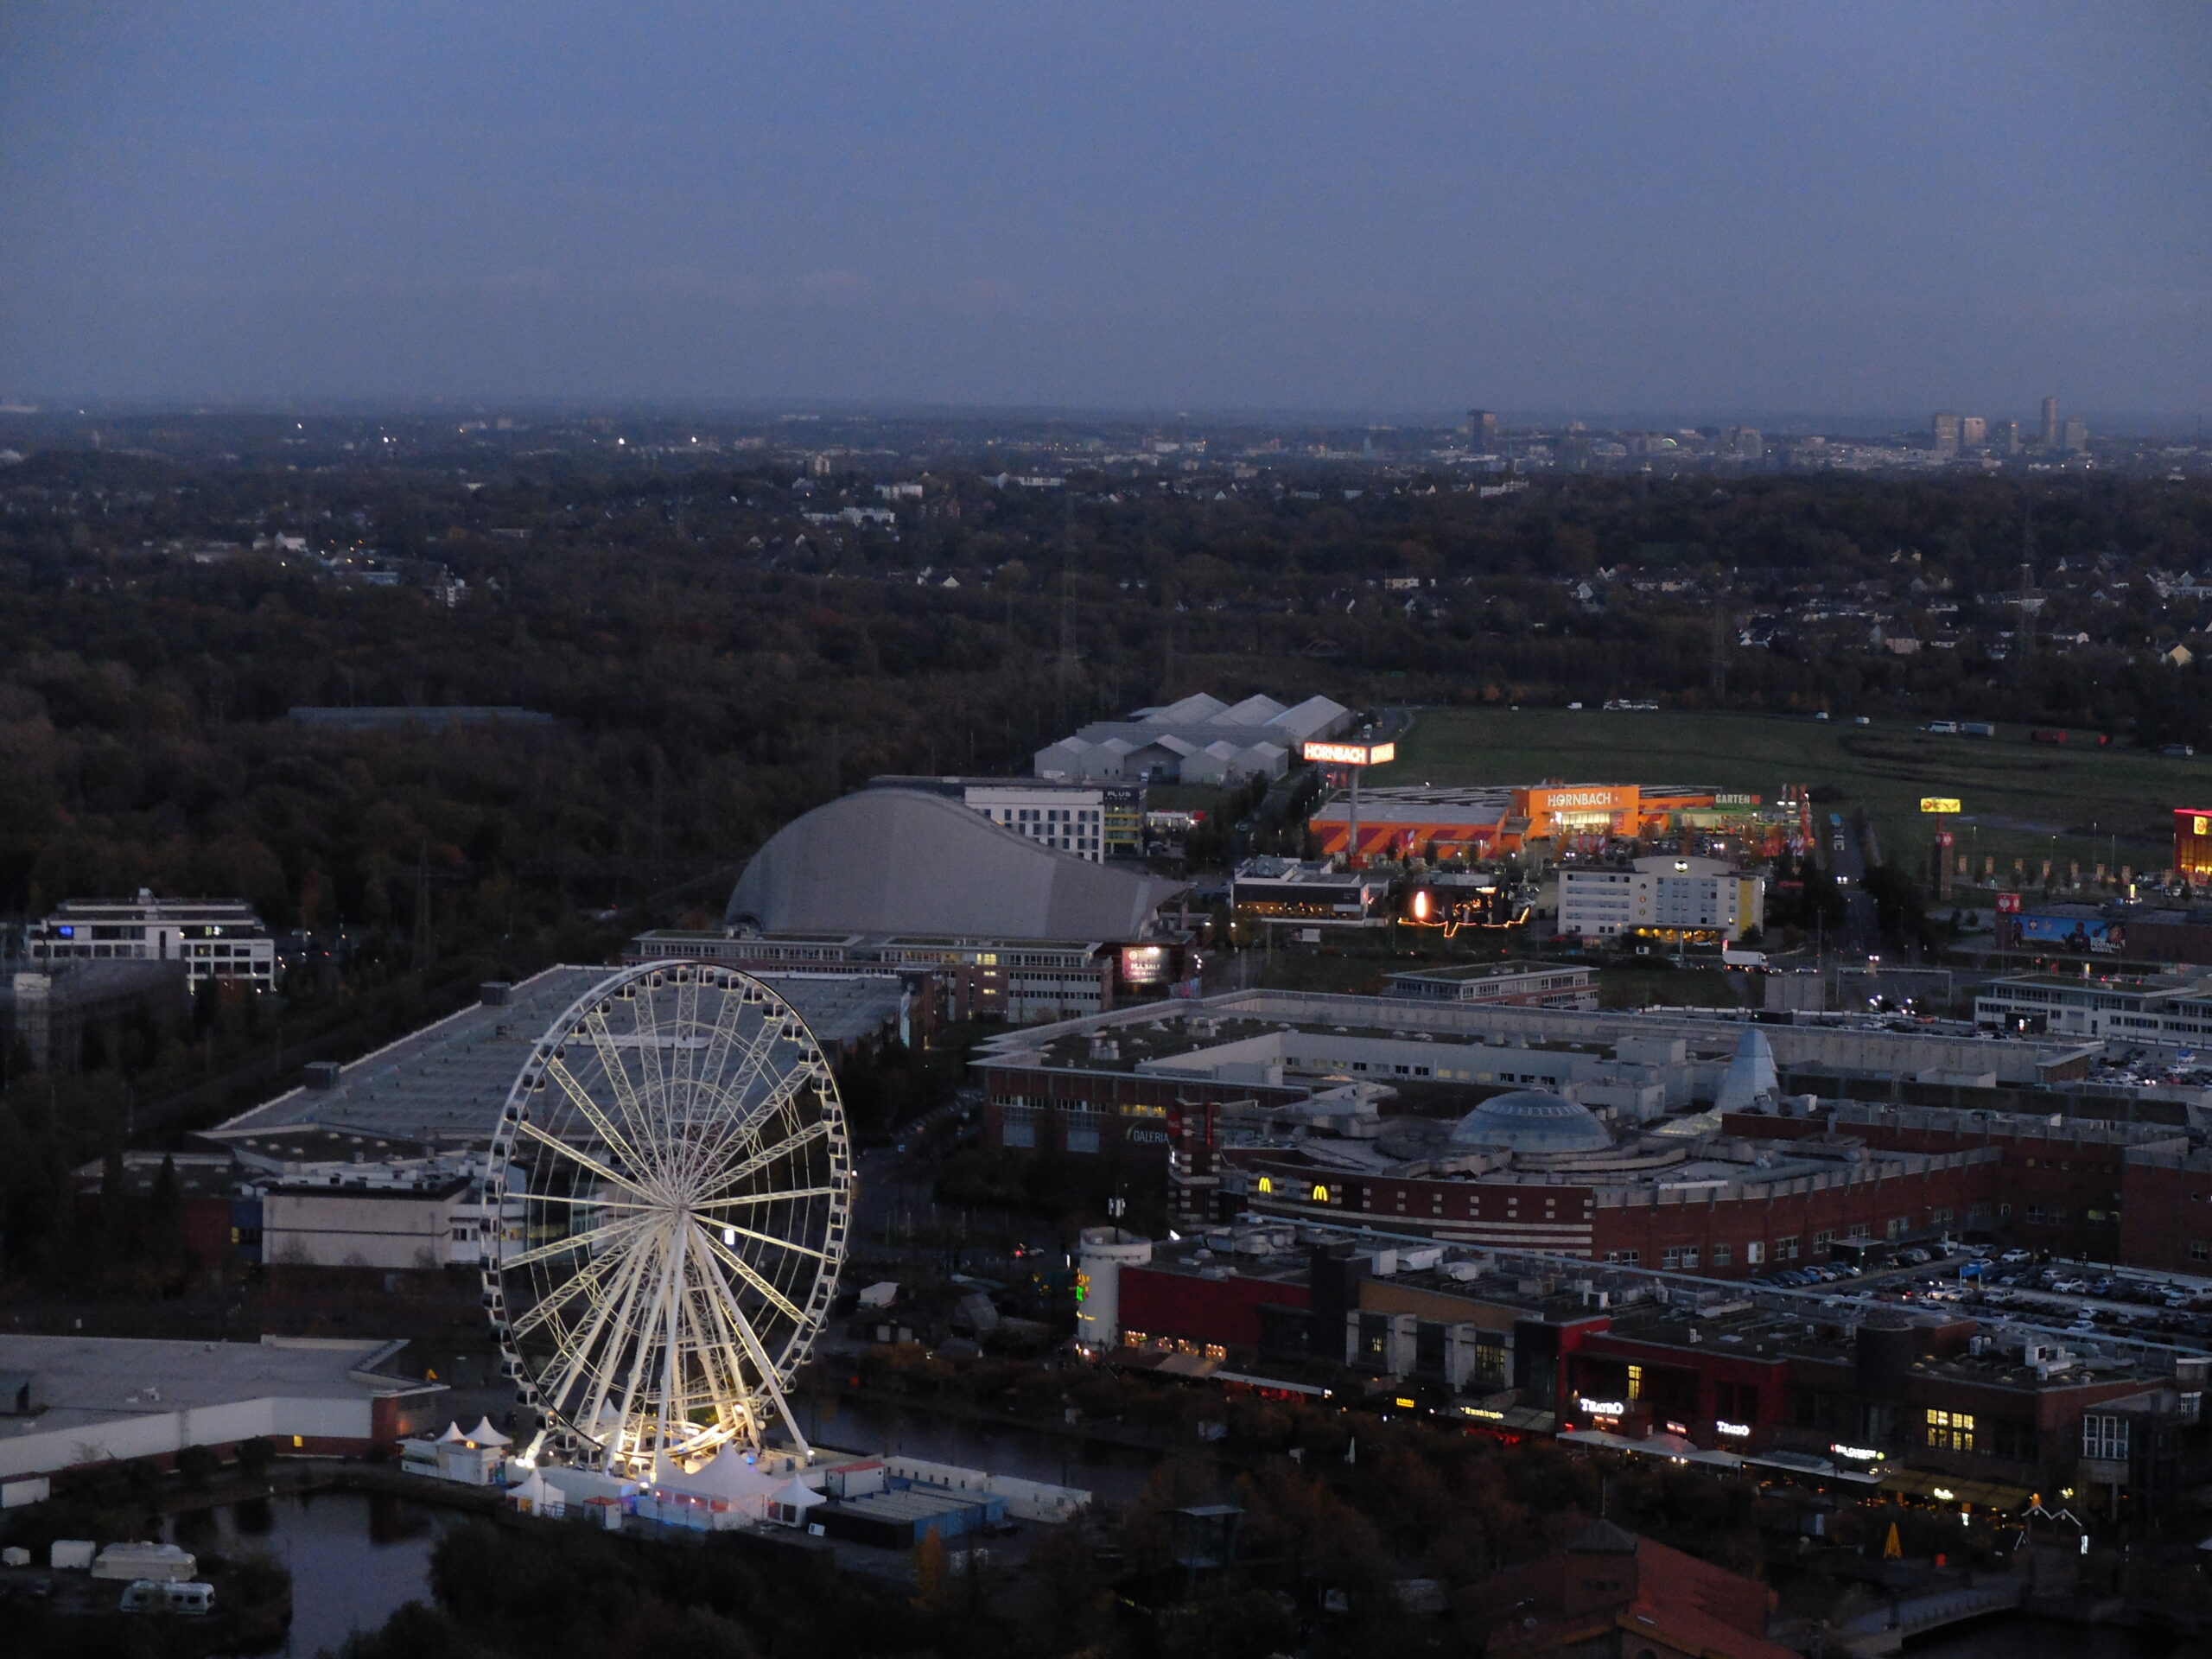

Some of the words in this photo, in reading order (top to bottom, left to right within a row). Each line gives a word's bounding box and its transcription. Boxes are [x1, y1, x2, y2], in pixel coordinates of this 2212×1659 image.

[1305, 744, 1366, 763] HORNBACH
[1548, 792, 1611, 807] HORNBACH
[1715, 794, 1751, 804] GARTEN
[1134, 1130, 1169, 1143] GALERIA
[1580, 1398, 1624, 1414] TEATRO
